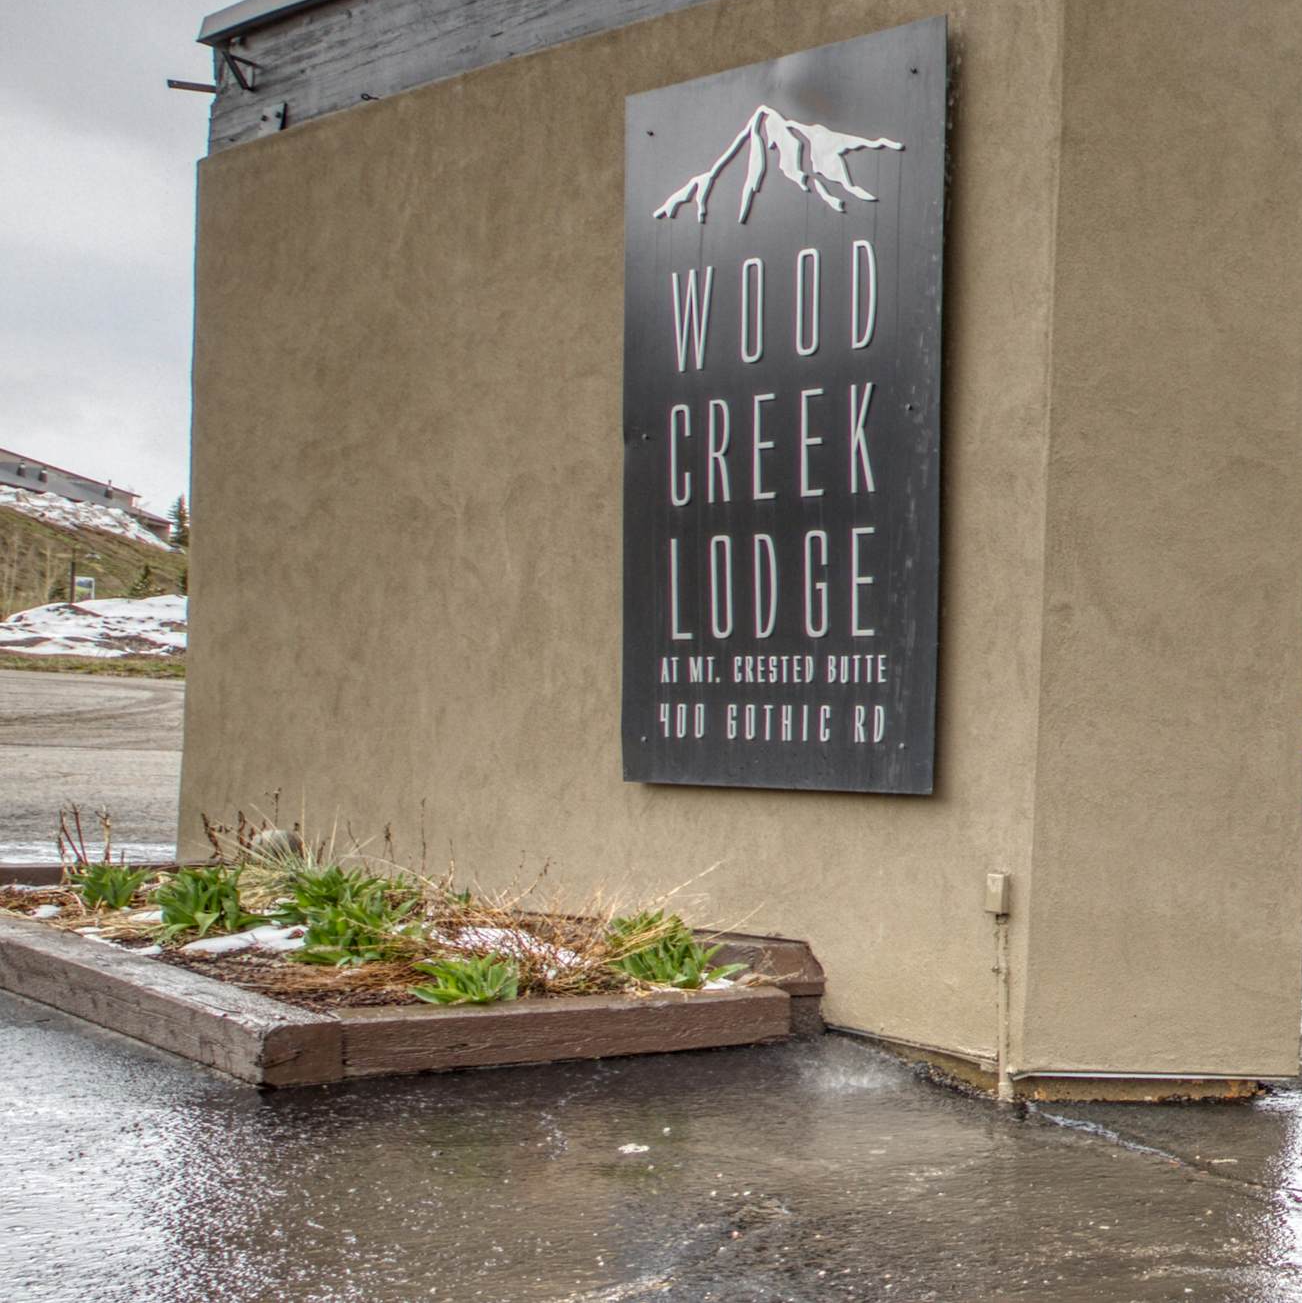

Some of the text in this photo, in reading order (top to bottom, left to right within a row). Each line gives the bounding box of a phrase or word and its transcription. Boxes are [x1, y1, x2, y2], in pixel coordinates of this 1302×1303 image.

[671, 239, 877, 373] WOOD
[670, 381, 876, 507] CREEK
[670, 526, 876, 641] LODGE
[659, 703, 886, 744] 400 GOTHIC RD
[660, 654, 888, 684] AT MT. CRESTED BUTTE
